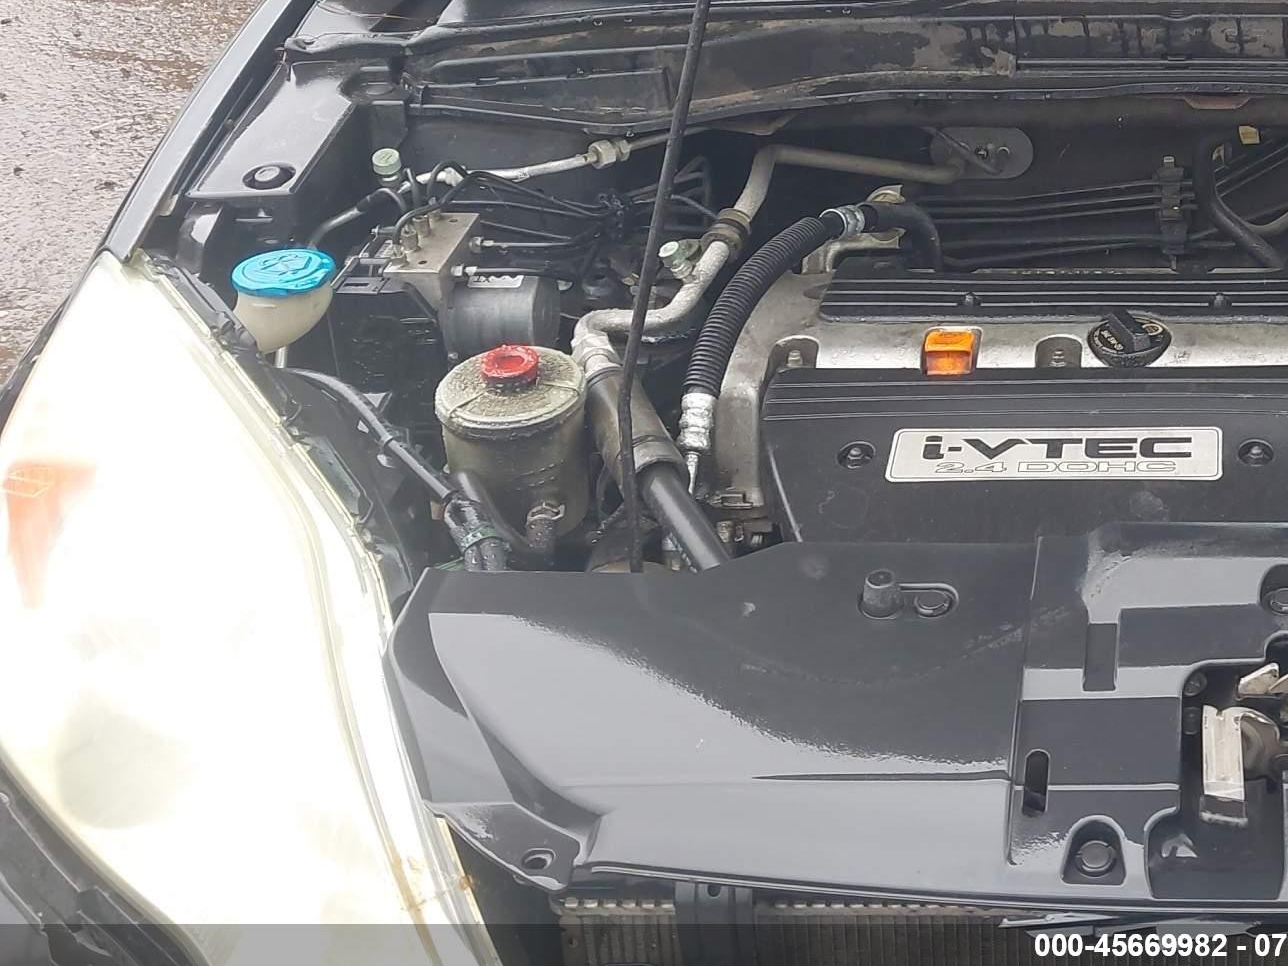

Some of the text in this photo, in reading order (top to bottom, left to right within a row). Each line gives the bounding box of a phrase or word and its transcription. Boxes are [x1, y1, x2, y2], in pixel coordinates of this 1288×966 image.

[922, 435, 1193, 460] i-VTEC
[935, 461, 1177, 473] 2.4 DOHC
